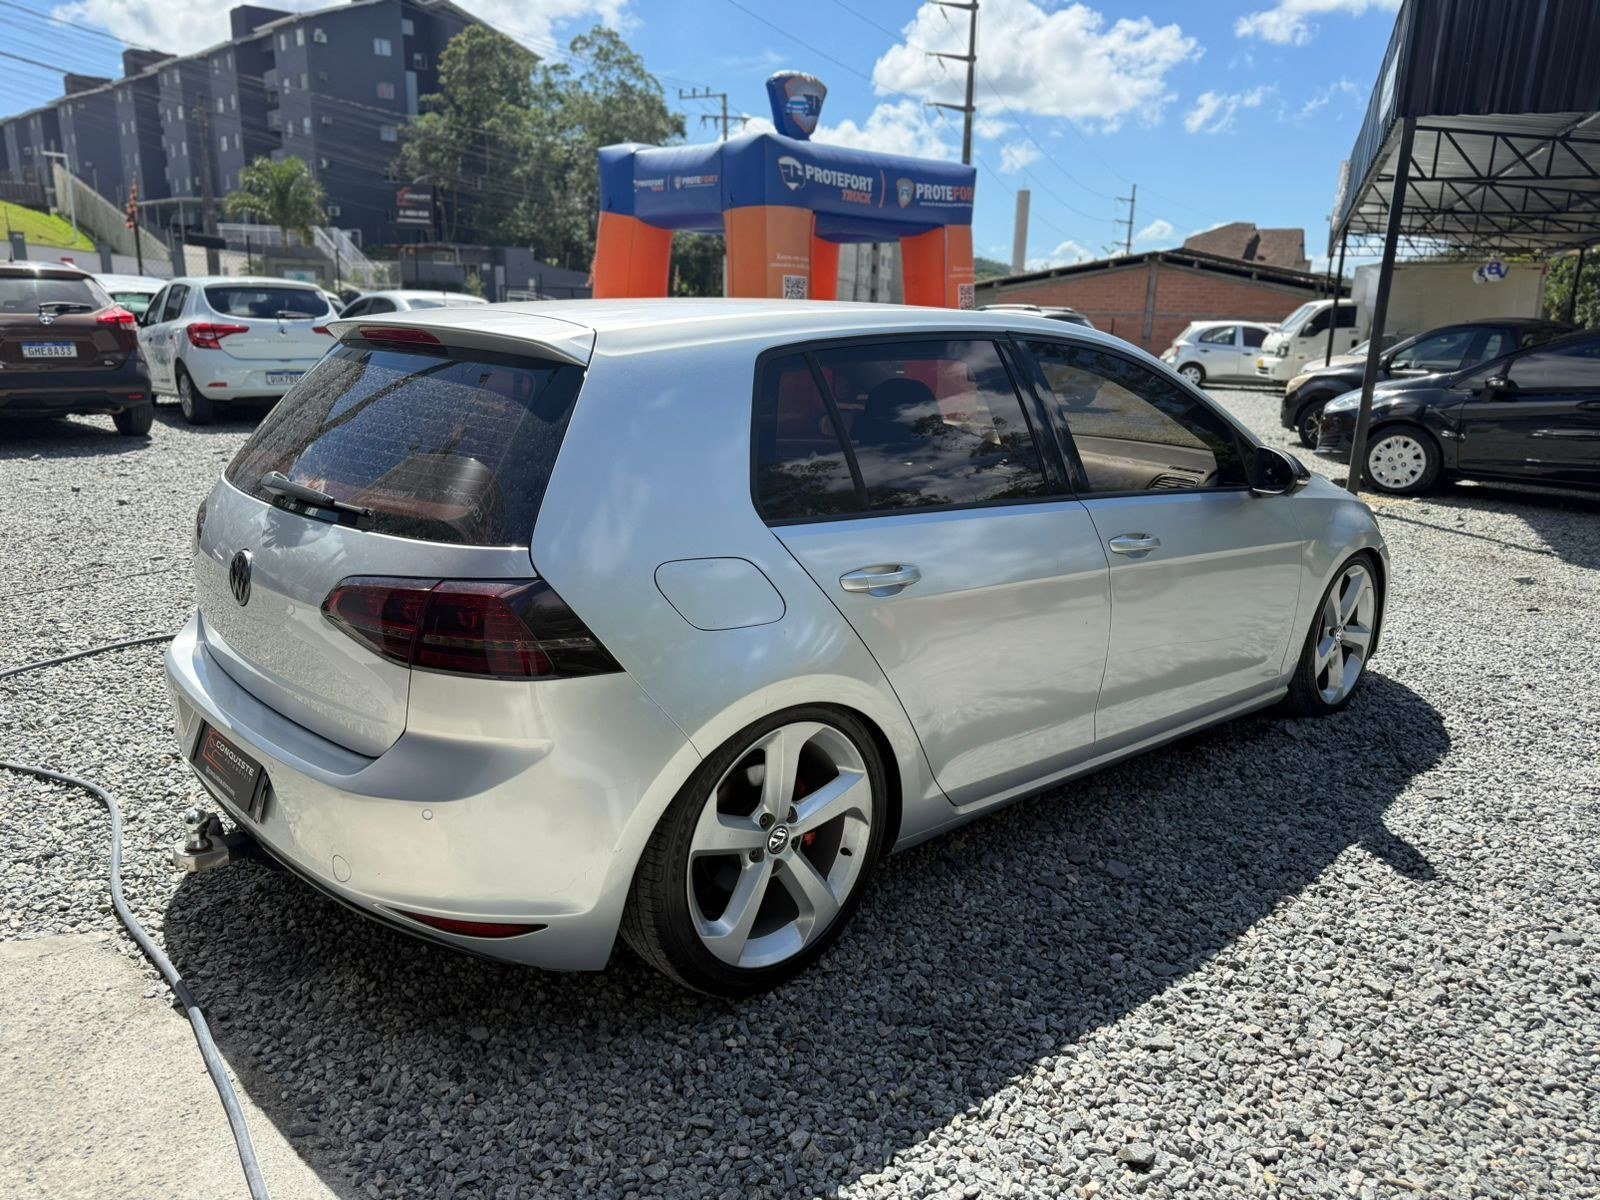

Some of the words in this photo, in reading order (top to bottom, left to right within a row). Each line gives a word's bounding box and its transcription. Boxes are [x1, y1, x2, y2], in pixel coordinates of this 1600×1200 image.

[805, 164, 873, 192] PROTEFORT
[842, 189, 872, 205] TRUCK
[915, 183, 973, 202] PROTEFOR
[215, 740, 255, 777] CONQUISTE
